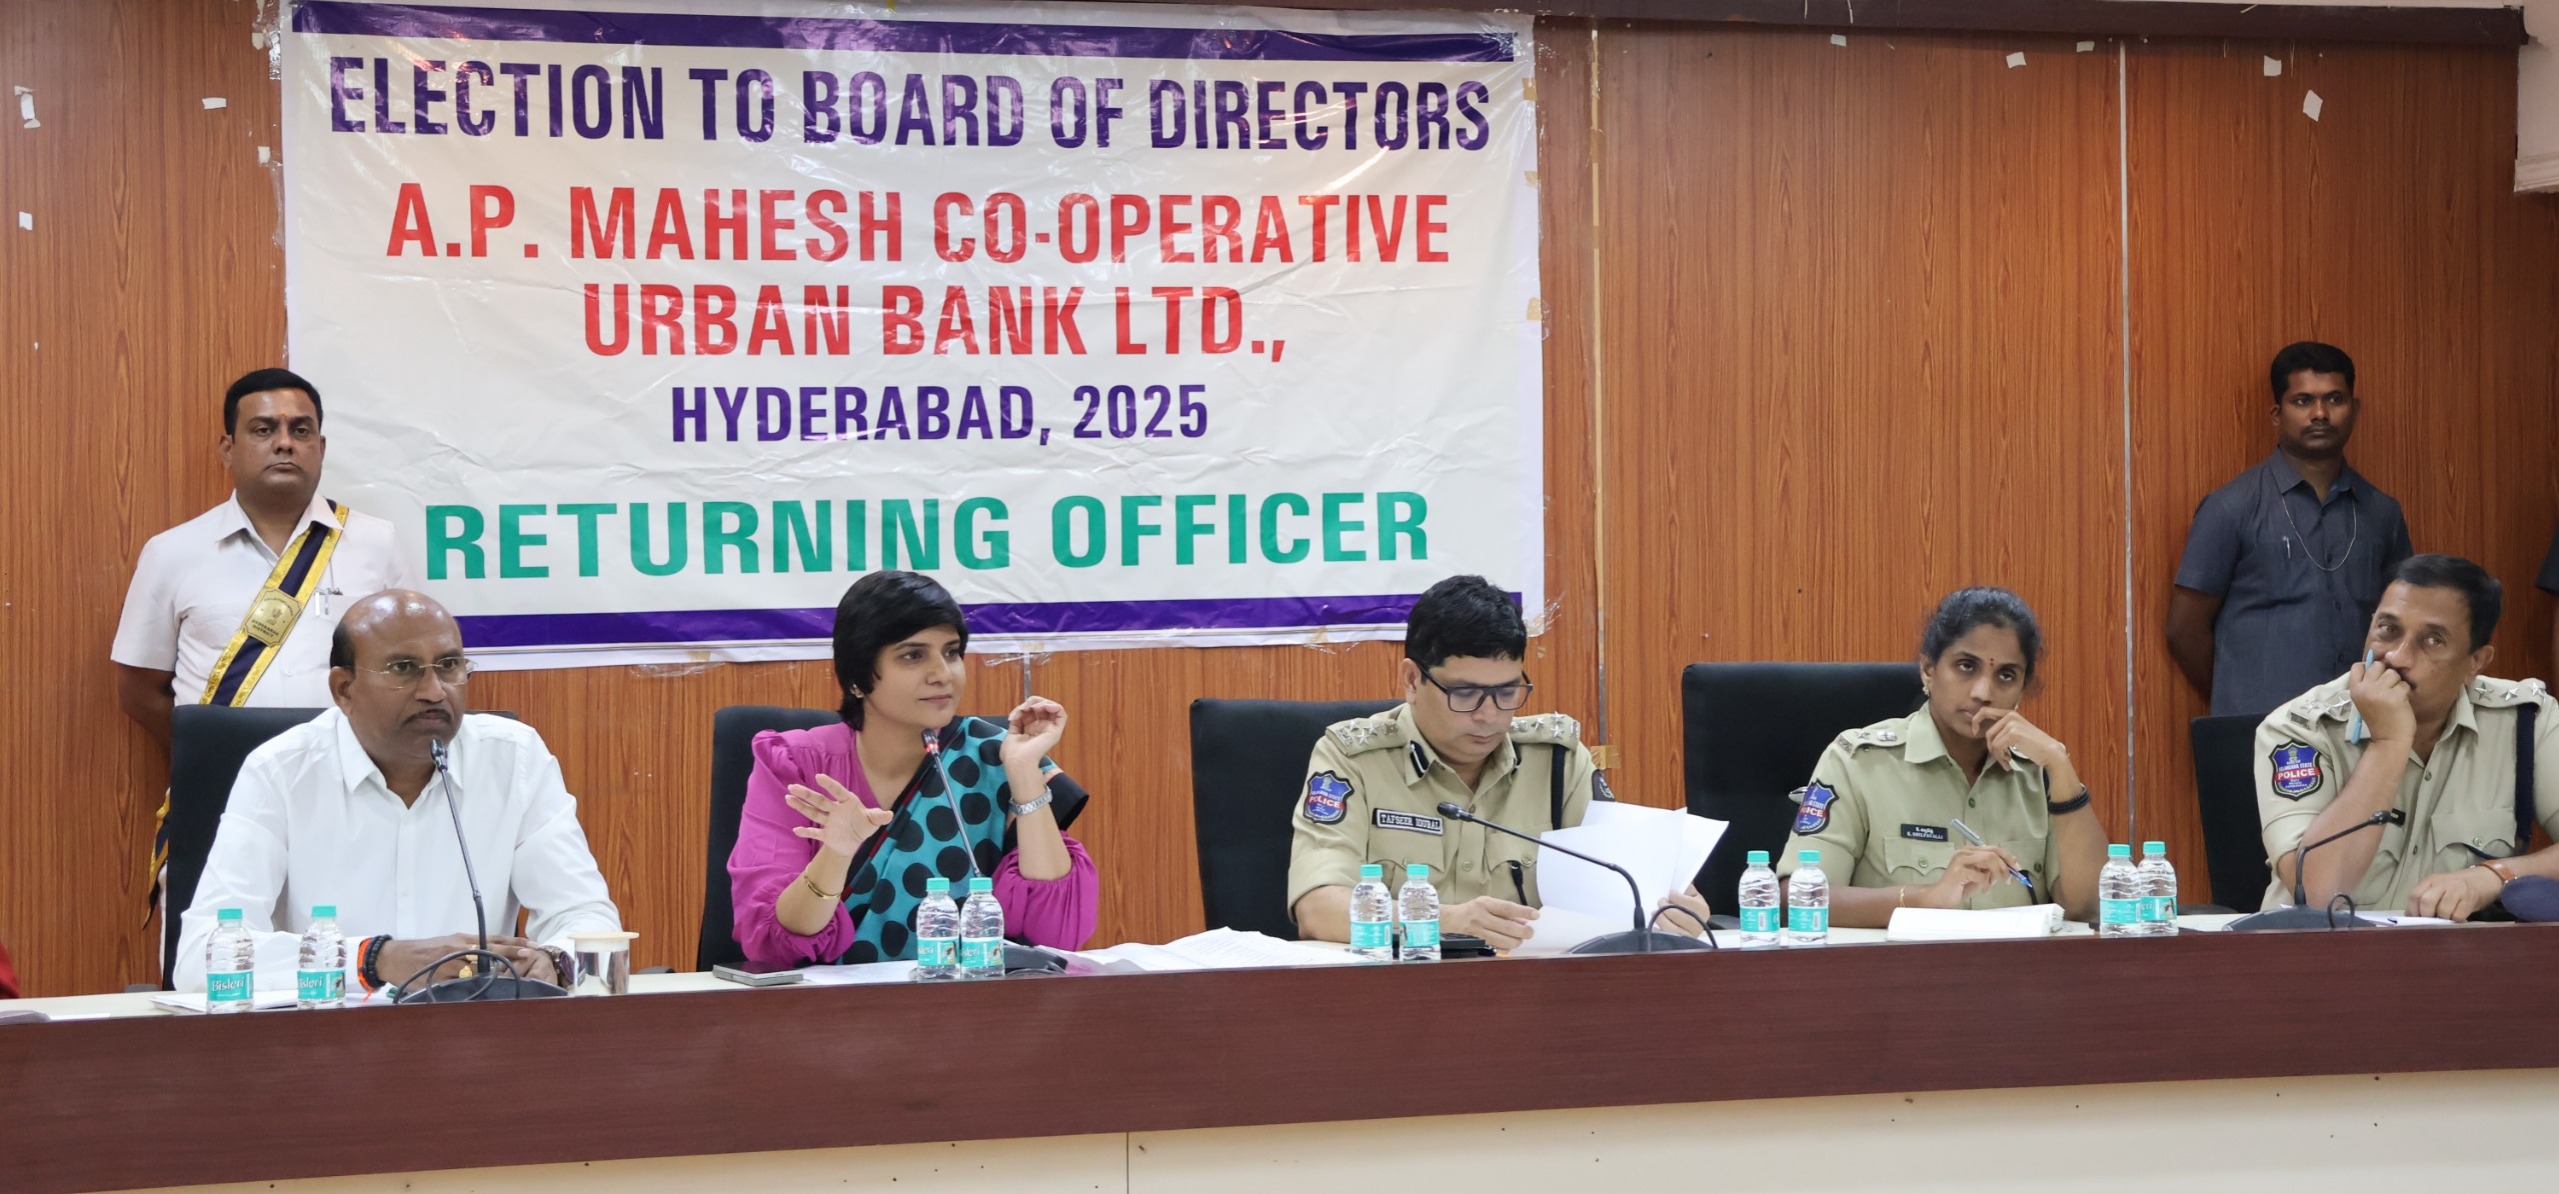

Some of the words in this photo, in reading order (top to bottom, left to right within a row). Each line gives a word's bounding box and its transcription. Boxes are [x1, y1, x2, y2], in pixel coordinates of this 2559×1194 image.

[330, 56, 664, 141] ELECTION
[689, 68, 775, 142] TO
[803, 71, 1024, 146] BOARD
[1051, 76, 1124, 148] OF
[1150, 79, 1490, 151] DIRECTORS
[386, 183, 539, 258] A.P.
[570, 186, 902, 262] MAHESH
[933, 192, 1449, 264] CO-OPERATIVE
[584, 283, 851, 357] URBAN
[882, 285, 1088, 356] BANK
[1115, 286, 1285, 363] LTD.,
[671, 386, 1051, 446] HYDERABAD,
[1073, 384, 1208, 440] 2025
[425, 497, 1011, 580] RETURNING
[1051, 491, 1429, 569] OFFICER
[2278, 768, 2316, 780] POLICE
[1309, 795, 1341, 809] POLICE
[1380, 814, 1414, 826] TAFSEER
[212, 977, 245, 992] Bisleri
[299, 976, 323, 989] isleri
